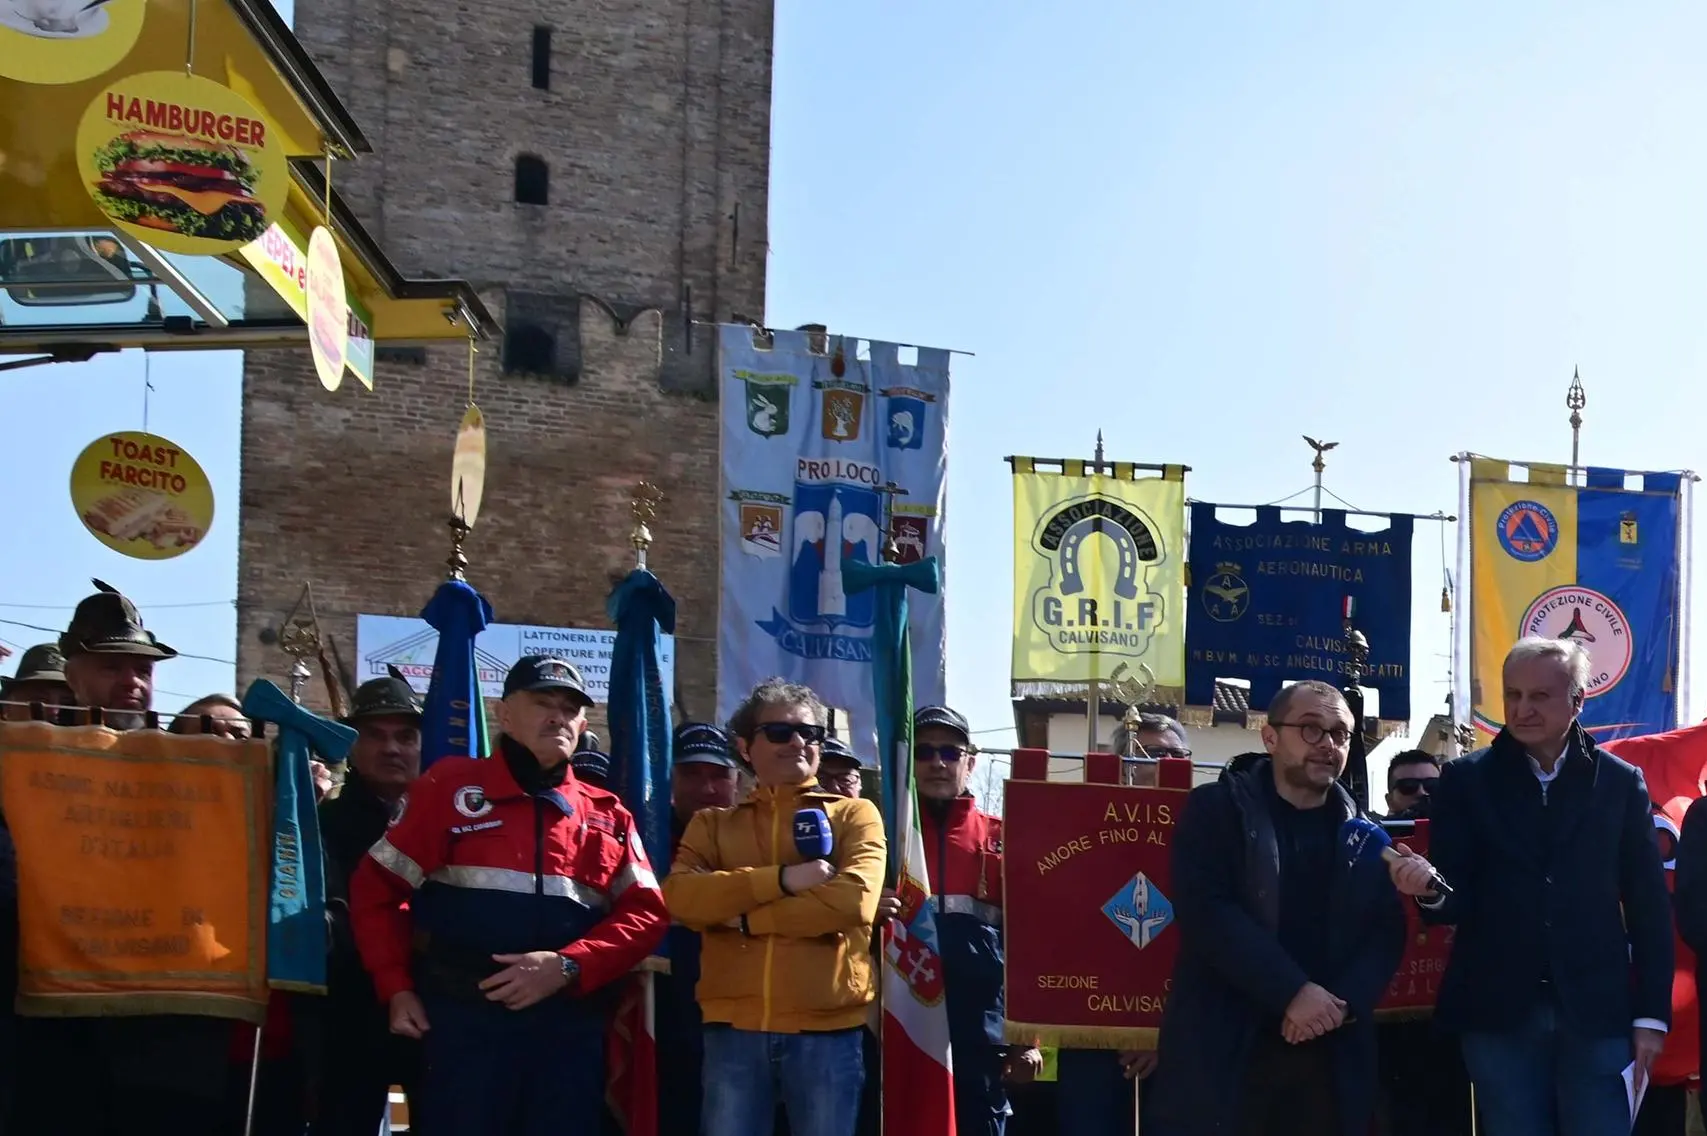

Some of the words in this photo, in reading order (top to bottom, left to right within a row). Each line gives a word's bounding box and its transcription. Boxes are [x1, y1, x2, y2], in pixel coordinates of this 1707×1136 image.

[106, 92, 265, 148] HAMBURGER
[110, 437, 180, 467] TOAST
[100, 460, 186, 493] FARCITO
[798, 458, 831, 480] PRO
[836, 462, 880, 485] LOCO
[1043, 500, 1153, 559] ASSOCIAZIONE
[1212, 533, 1331, 552] ASSOCIAZIONE
[1341, 541, 1393, 556] ARMA
[1223, 576, 1232, 589] A
[1256, 561, 1364, 583] AERONAUTICA
[1230, 603, 1240, 616] A
[1530, 594, 1593, 633] PROTEZIONE
[1595, 603, 1623, 636] CIVILE
[524, 630, 596, 644] LATTONERIA
[782, 629, 872, 661] CAVISAN
[1059, 630, 1138, 647] CALVISANO
[524, 646, 595, 659] COPERTURE
[1286, 654, 1334, 672] ANGELO
[1104, 802, 1175, 825] A.V.I.S.
[1036, 835, 1093, 875] AMORE
[1099, 828, 1139, 845] FINO
[1147, 830, 1166, 846] AL
[1038, 975, 1099, 990] SEZIONE
[1087, 995, 1168, 1012] CALVISA
